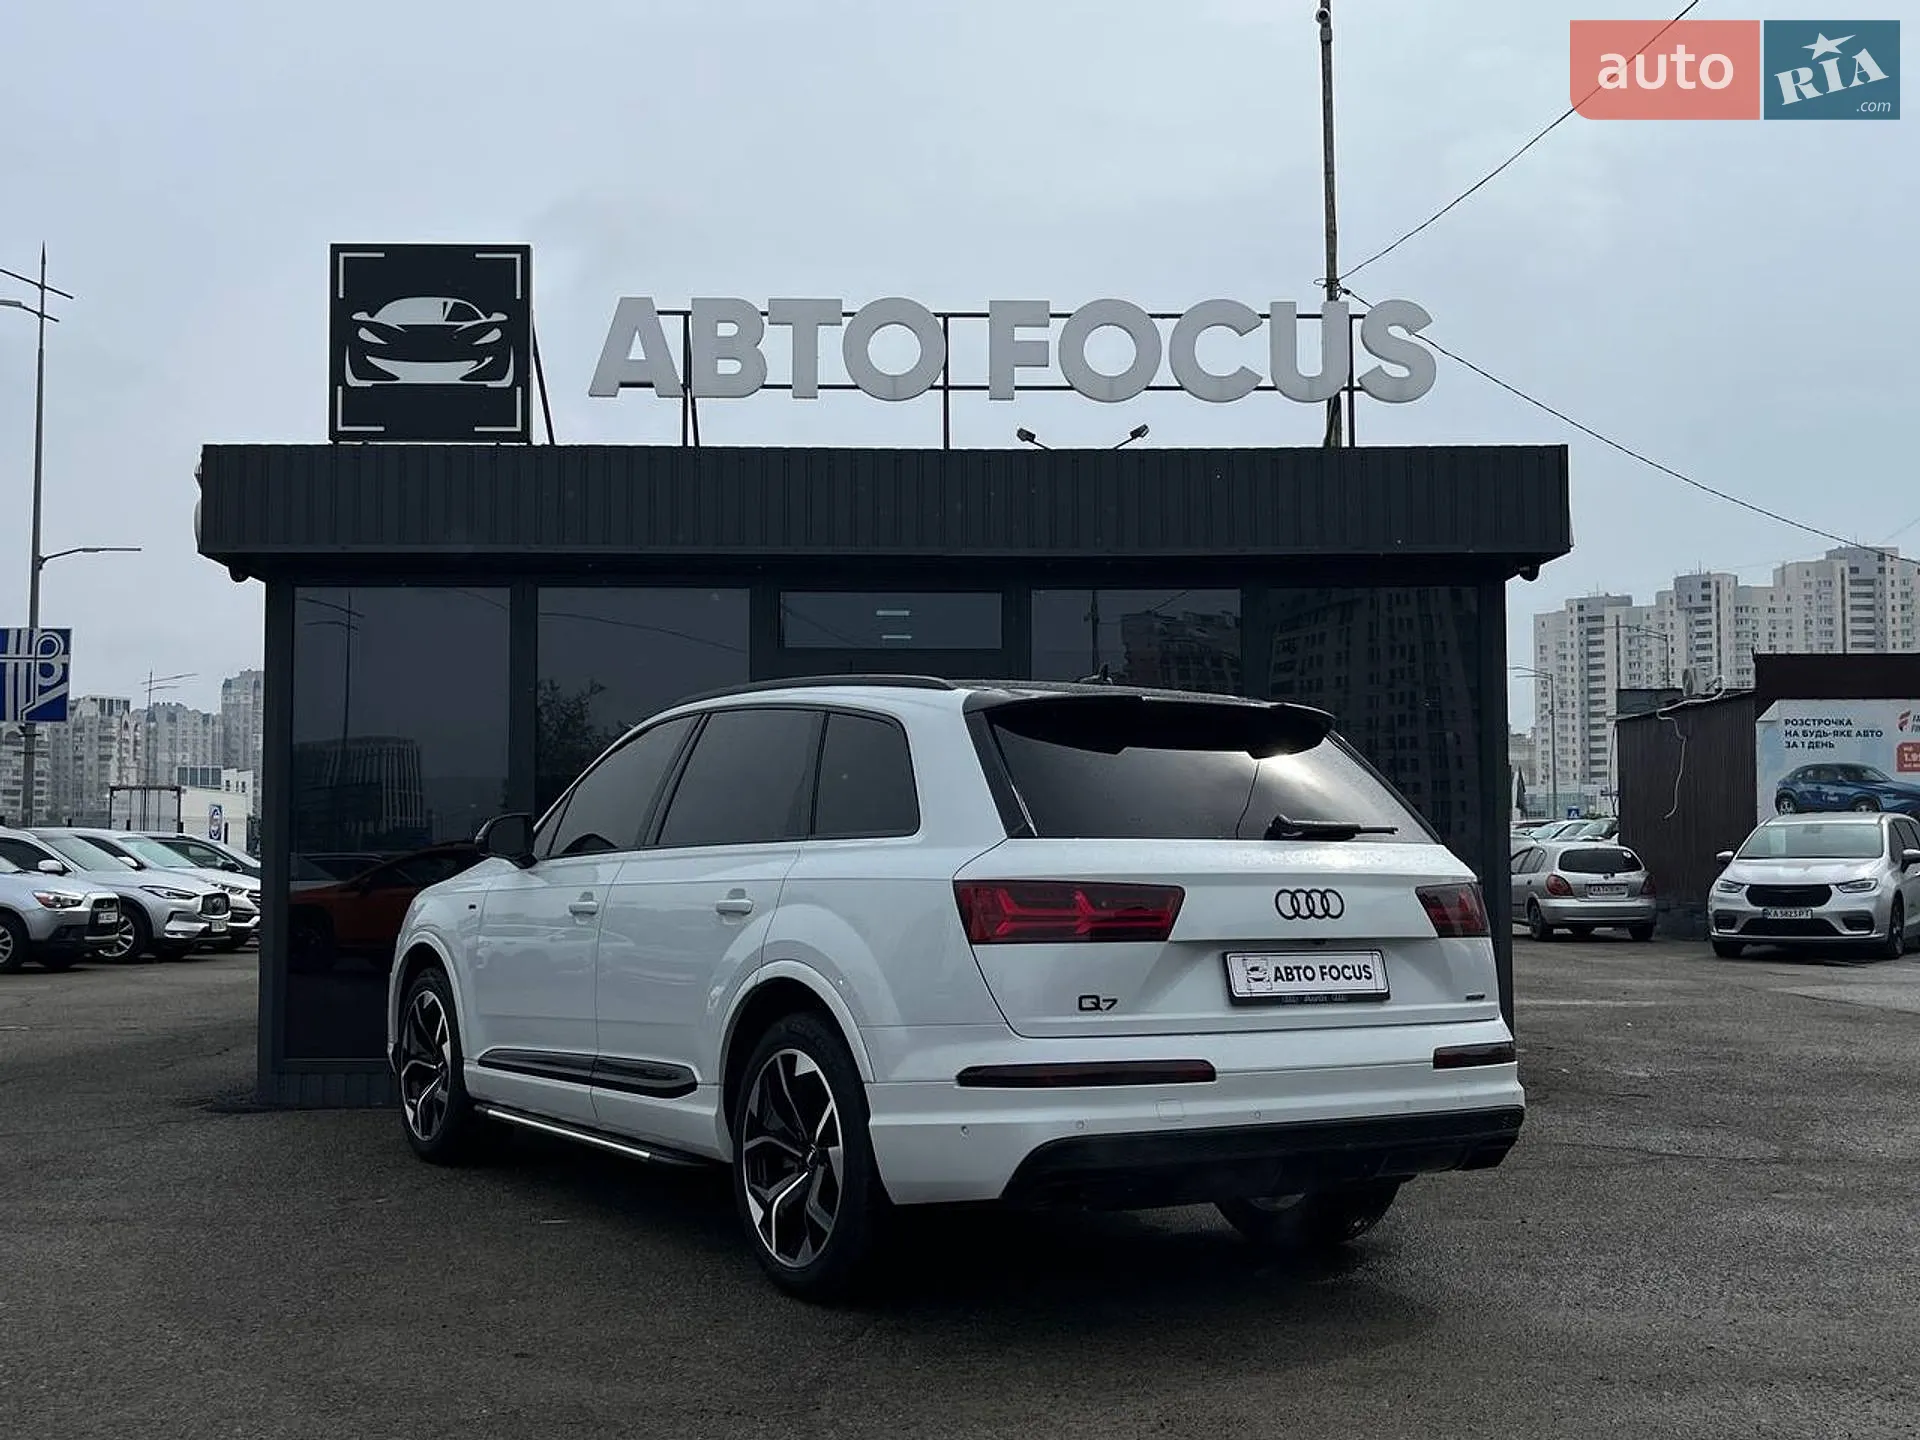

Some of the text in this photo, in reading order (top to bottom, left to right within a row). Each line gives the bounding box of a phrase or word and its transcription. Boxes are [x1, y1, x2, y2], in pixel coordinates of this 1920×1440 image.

[588, 297, 1437, 403] АВТО FOCUS
[1783, 718, 1853, 727] РОЗСТРОЧКА
[1784, 729, 1884, 739] НА БУДЬ-ЯКЕ АВТО
[1784, 740, 1798, 749] ЗА
[1807, 740, 1835, 750] ДЕНЬ
[1273, 963, 1373, 983] АВТО FOCUS
[1078, 995, 1118, 1012] Q7
